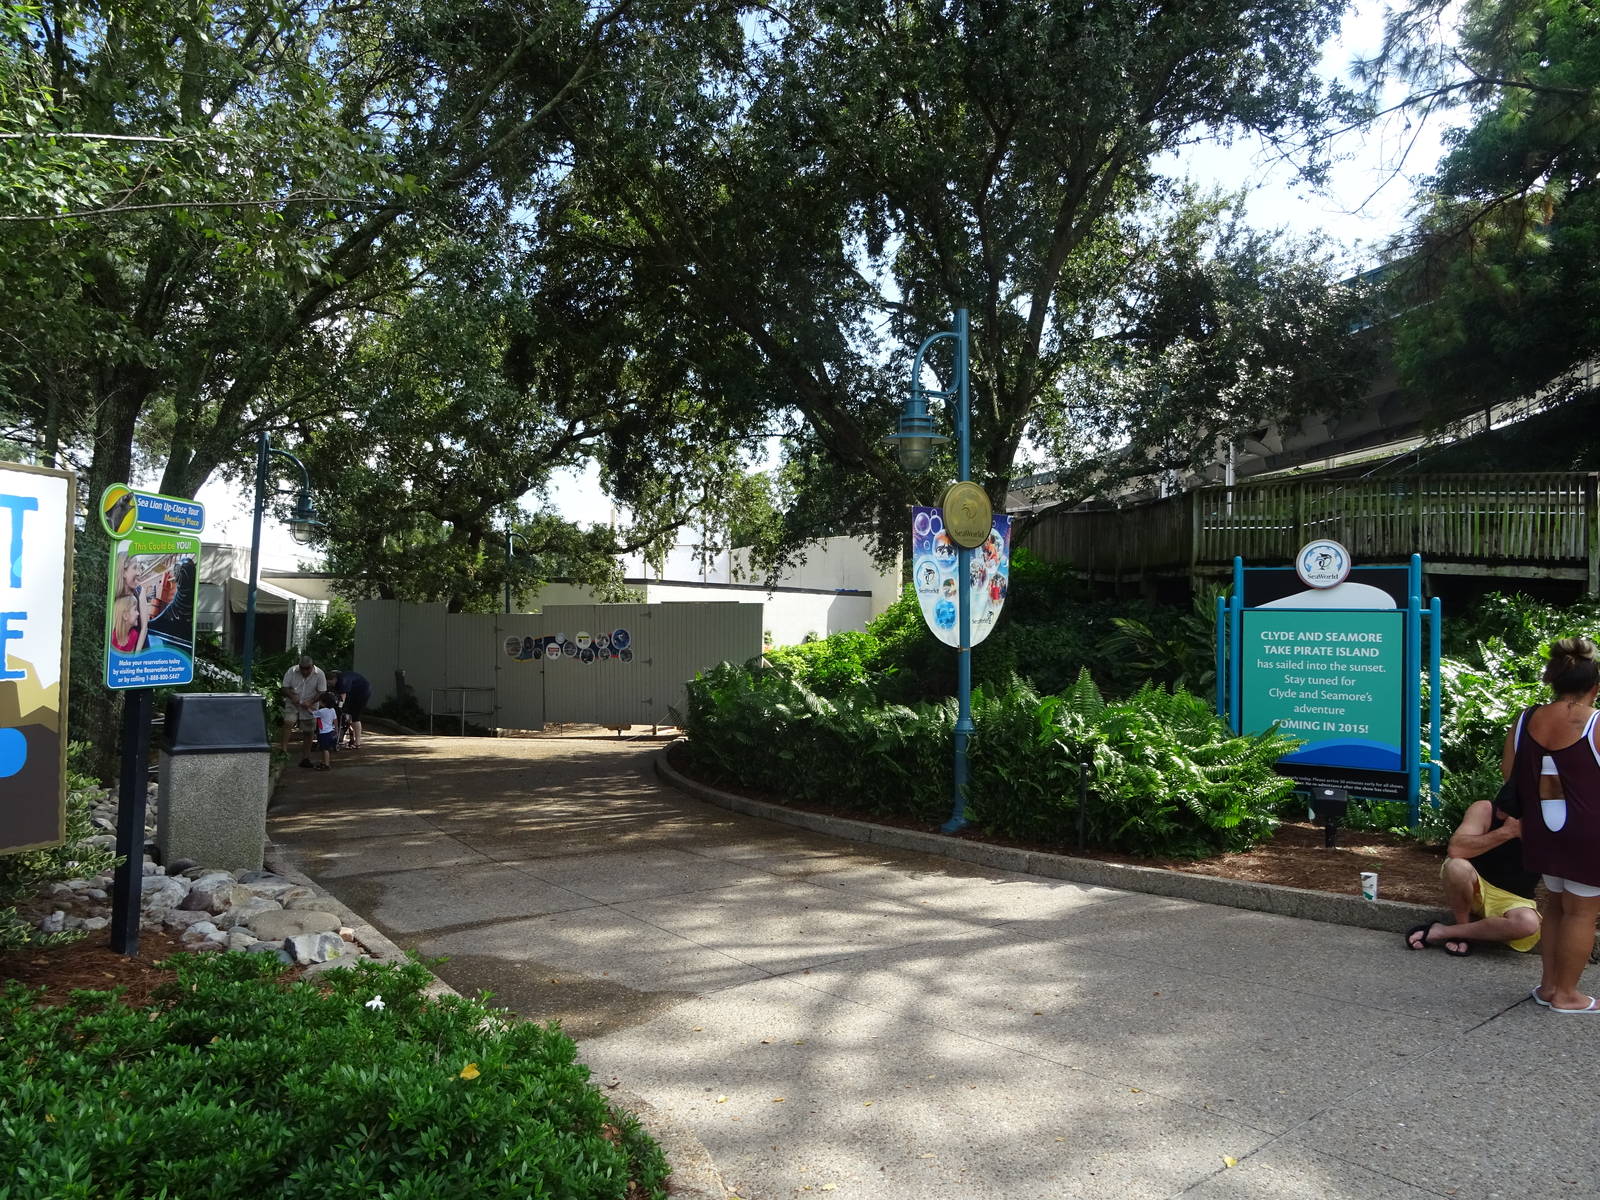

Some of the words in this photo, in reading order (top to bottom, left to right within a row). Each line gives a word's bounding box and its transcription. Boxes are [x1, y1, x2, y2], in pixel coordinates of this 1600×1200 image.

[137, 498, 148, 507] Sea
[150, 500, 162, 510] Lion
[164, 503, 187, 514] Up-Close
[188, 507, 199, 516] Tour
[164, 514, 186, 526] Meeting
[186, 518, 199, 526] Place
[134, 542, 147, 550] This
[148, 542, 166, 550] Could
[176, 541, 192, 550] YOU!
[1260, 631, 1295, 640] CLYDE
[1297, 632, 1324, 641] AND
[1325, 632, 1383, 643] SEAMORE
[1264, 645, 1291, 655] TAKE
[1294, 646, 1334, 656] PIRATE
[1336, 647, 1380, 657] ISLAND
[1257, 659, 1274, 669] has
[1275, 660, 1304, 670] sailed
[1306, 661, 1327, 671] into
[1330, 662, 1347, 671] the
[1349, 664, 1387, 673] sunset.
[1284, 674, 1306, 686] Stay
[1308, 676, 1338, 686] tuned
[1341, 676, 1357, 686] for
[1269, 688, 1297, 700] Clyde
[1299, 690, 1318, 700] and
[1321, 690, 1373, 702] Seamore's
[1294, 704, 1345, 715] adventure
[1272, 719, 1320, 731] COMING
[1323, 721, 1335, 732] IN
[1338, 723, 1369, 734] 2015!
